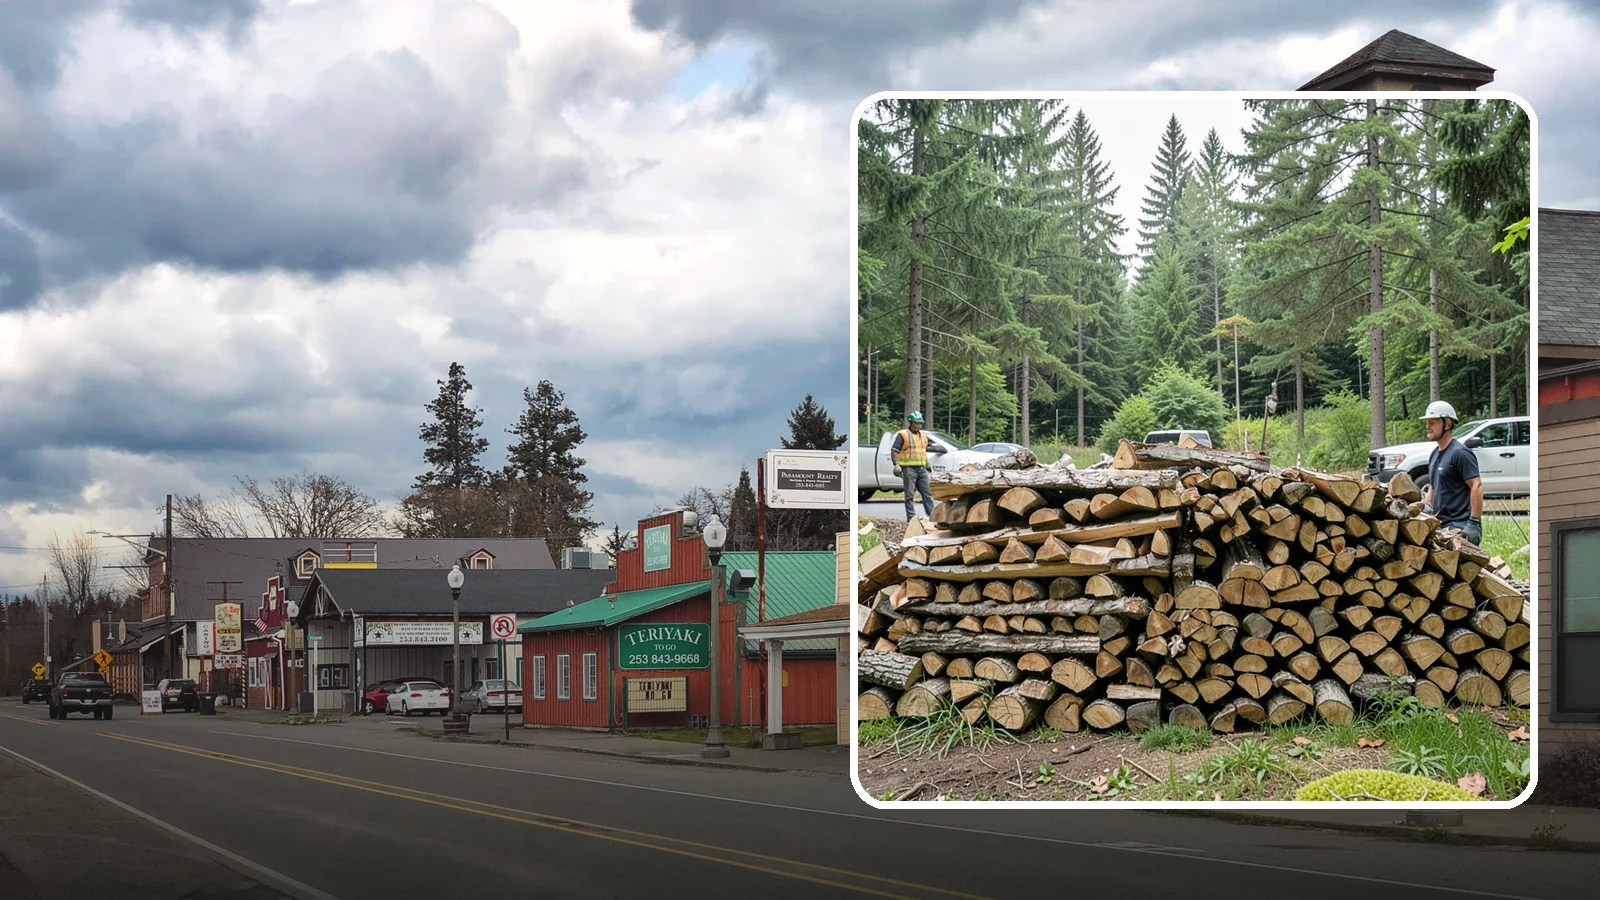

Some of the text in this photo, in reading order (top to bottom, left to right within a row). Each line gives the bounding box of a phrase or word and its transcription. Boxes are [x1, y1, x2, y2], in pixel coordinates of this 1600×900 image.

[781, 471, 839, 480] PARAMOUNT REALTY
[624, 627, 702, 646] TERIYAKI
[653, 643, 677, 651] TO GO
[628, 653, 700, 665] 253 843-9668
